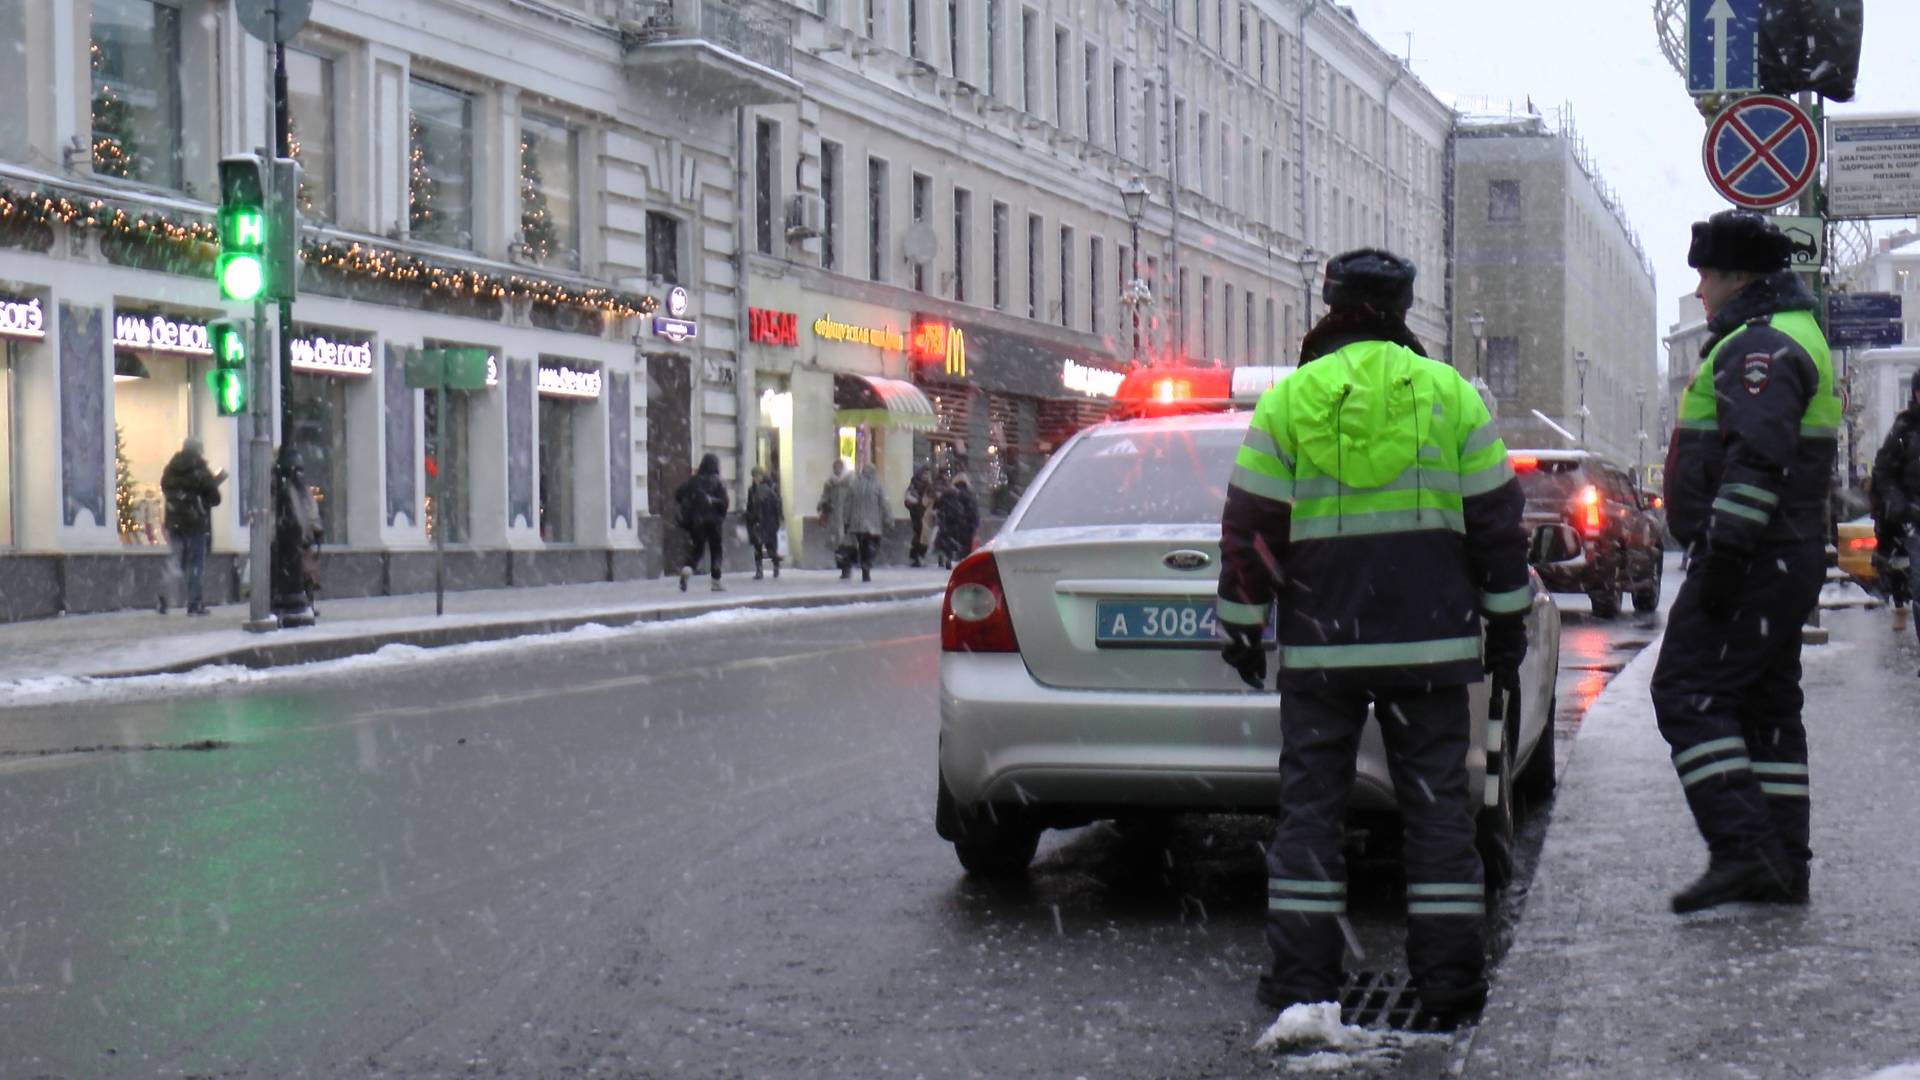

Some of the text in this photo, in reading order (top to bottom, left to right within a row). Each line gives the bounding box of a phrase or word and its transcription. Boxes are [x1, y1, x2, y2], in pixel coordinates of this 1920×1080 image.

[1873, 172, 1910, 180] ПИТАНИЕ
[749, 306, 798, 347] ТАБАК
[1142, 607, 1217, 637] 3084
